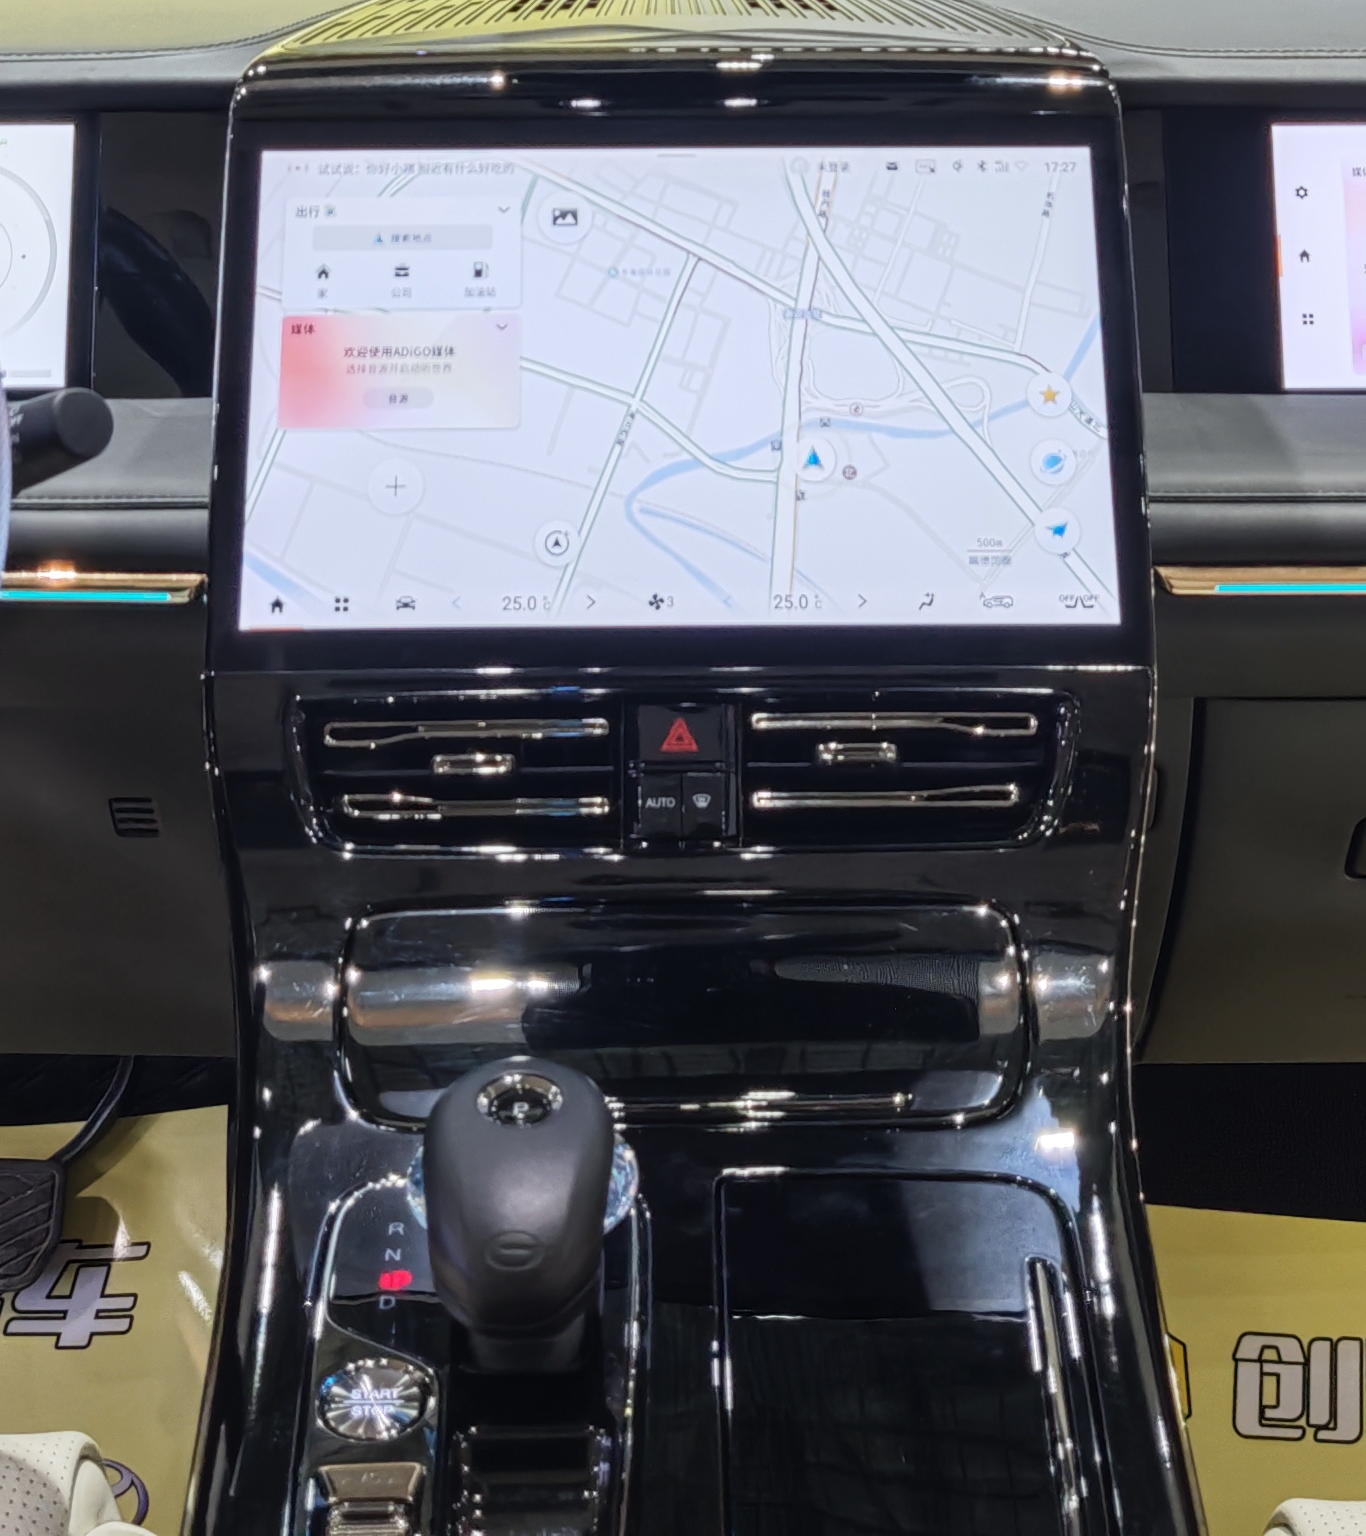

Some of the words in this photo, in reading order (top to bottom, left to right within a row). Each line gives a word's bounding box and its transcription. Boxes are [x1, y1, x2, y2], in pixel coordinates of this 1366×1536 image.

[1045, 161, 1076, 172] 17:27
[291, 324, 315, 335] 媒体
[502, 596, 537, 610] 25.0
[667, 596, 674, 607] 3
[773, 594, 808, 610] 25.0
[646, 797, 675, 808] AUTO
[514, 1102, 526, 1114] P
[389, 1222, 404, 1236] R
[386, 1249, 402, 1261] N
[379, 1296, 395, 1309] D
[351, 1389, 399, 1402] START
[352, 1404, 394, 1418] STOP
